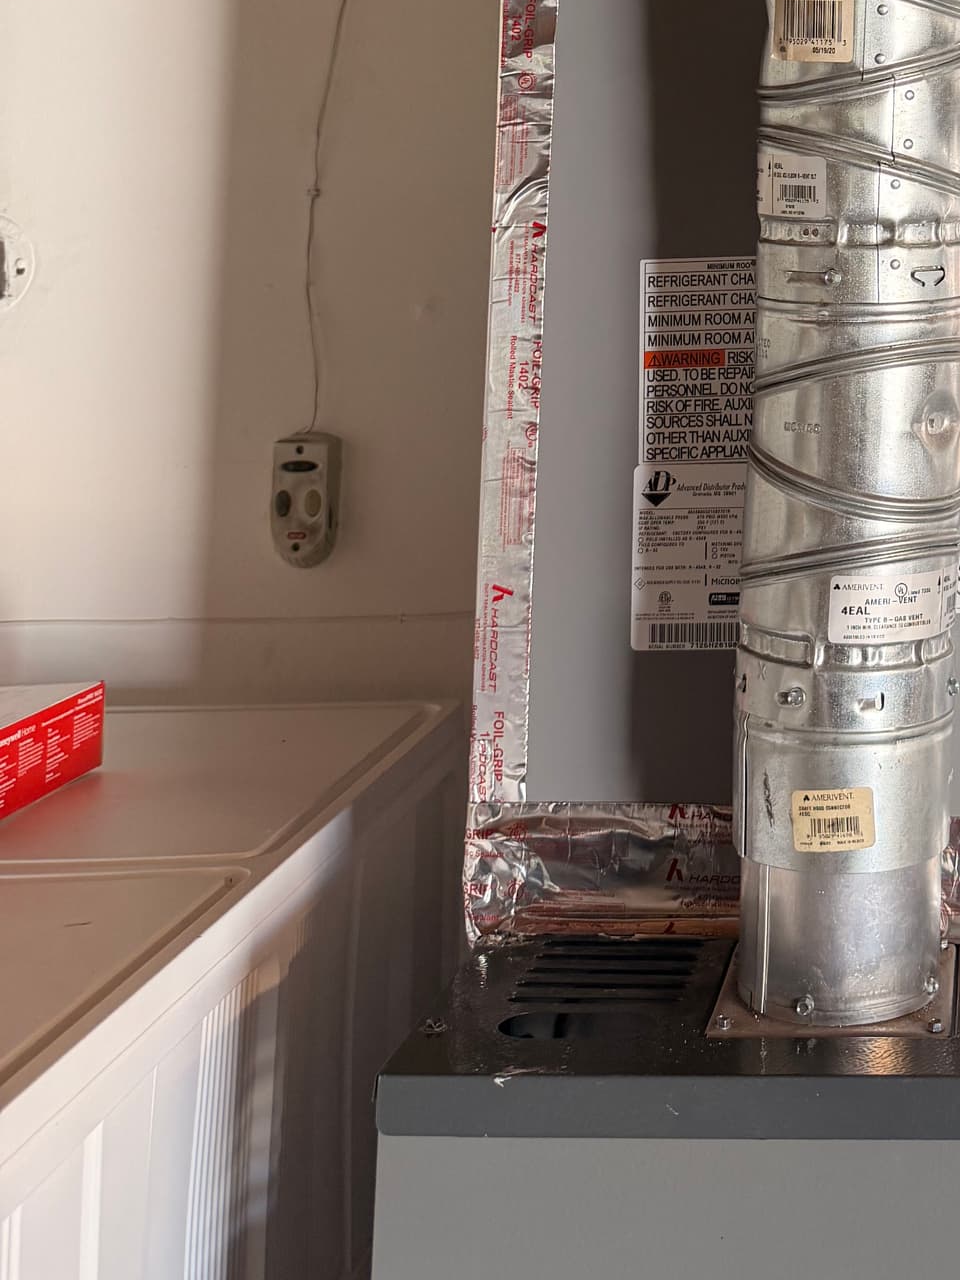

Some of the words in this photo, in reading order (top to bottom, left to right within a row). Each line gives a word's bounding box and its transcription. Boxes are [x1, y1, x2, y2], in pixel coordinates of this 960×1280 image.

[512, 15, 522, 40] 1402
[528, 243, 538, 324] HARDCAST
[648, 274, 728, 288] REFRIGERANT
[648, 294, 728, 308] REFRIGERANT
[648, 314, 700, 327] MINIMUM
[705, 313, 741, 326] ROOM
[648, 333, 700, 347] MINIMUM
[705, 332, 741, 345] ROOM
[661, 352, 721, 365] WARNING
[728, 352, 754, 364] RISK
[518, 360, 529, 389] 1402
[684, 369, 698, 381] TO
[701, 368, 716, 380] BE
[721, 383, 737, 395] DO
[647, 400, 673, 413] RISK
[675, 400, 692, 412] OF
[694, 399, 722, 411] FIRE.
[647, 416, 703, 429] SOURCES
[706, 415, 742, 427] SHALL
[647, 432, 687, 445] OTHER
[689, 430, 721, 443] THAN
[647, 446, 698, 460] SPECIFIC
[841, 606, 870, 615] 4EAL
[489, 608, 499, 693] HARDCAST
[493, 711, 504, 782] FOIL-GRIP
